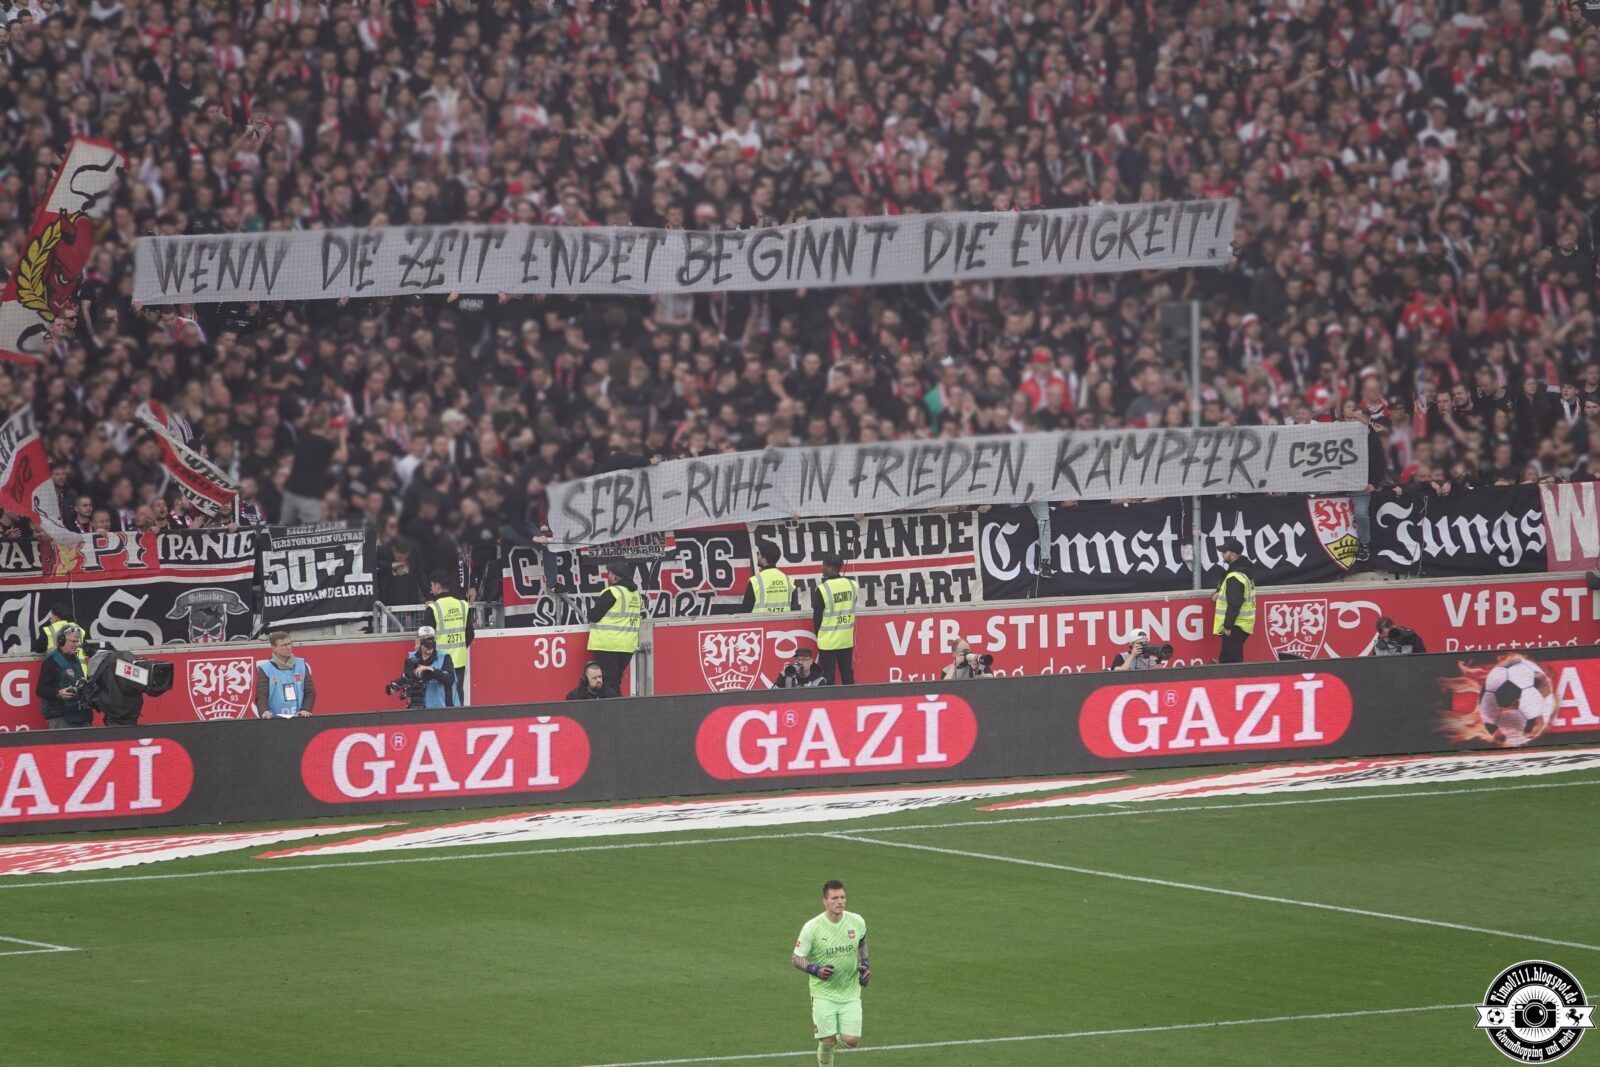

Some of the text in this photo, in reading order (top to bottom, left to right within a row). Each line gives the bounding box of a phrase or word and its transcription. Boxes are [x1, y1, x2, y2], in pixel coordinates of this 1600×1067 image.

[153, 203, 1229, 295] WENN DIE ZEIT ENDET BEGINNT DIE EWIGKEIT!
[800, 447, 838, 507] IN
[848, 440, 1035, 502] FRIEDEN,
[334, 531, 363, 542] ULTRAS
[753, 512, 974, 563] SÜDBANDE
[262, 543, 373, 594] 50+1
[671, 537, 735, 592] 36
[264, 584, 374, 607] UNVERHANDELBAR
[534, 636, 567, 669] 36
[885, 605, 1204, 656] VfB-STIFTUNG
